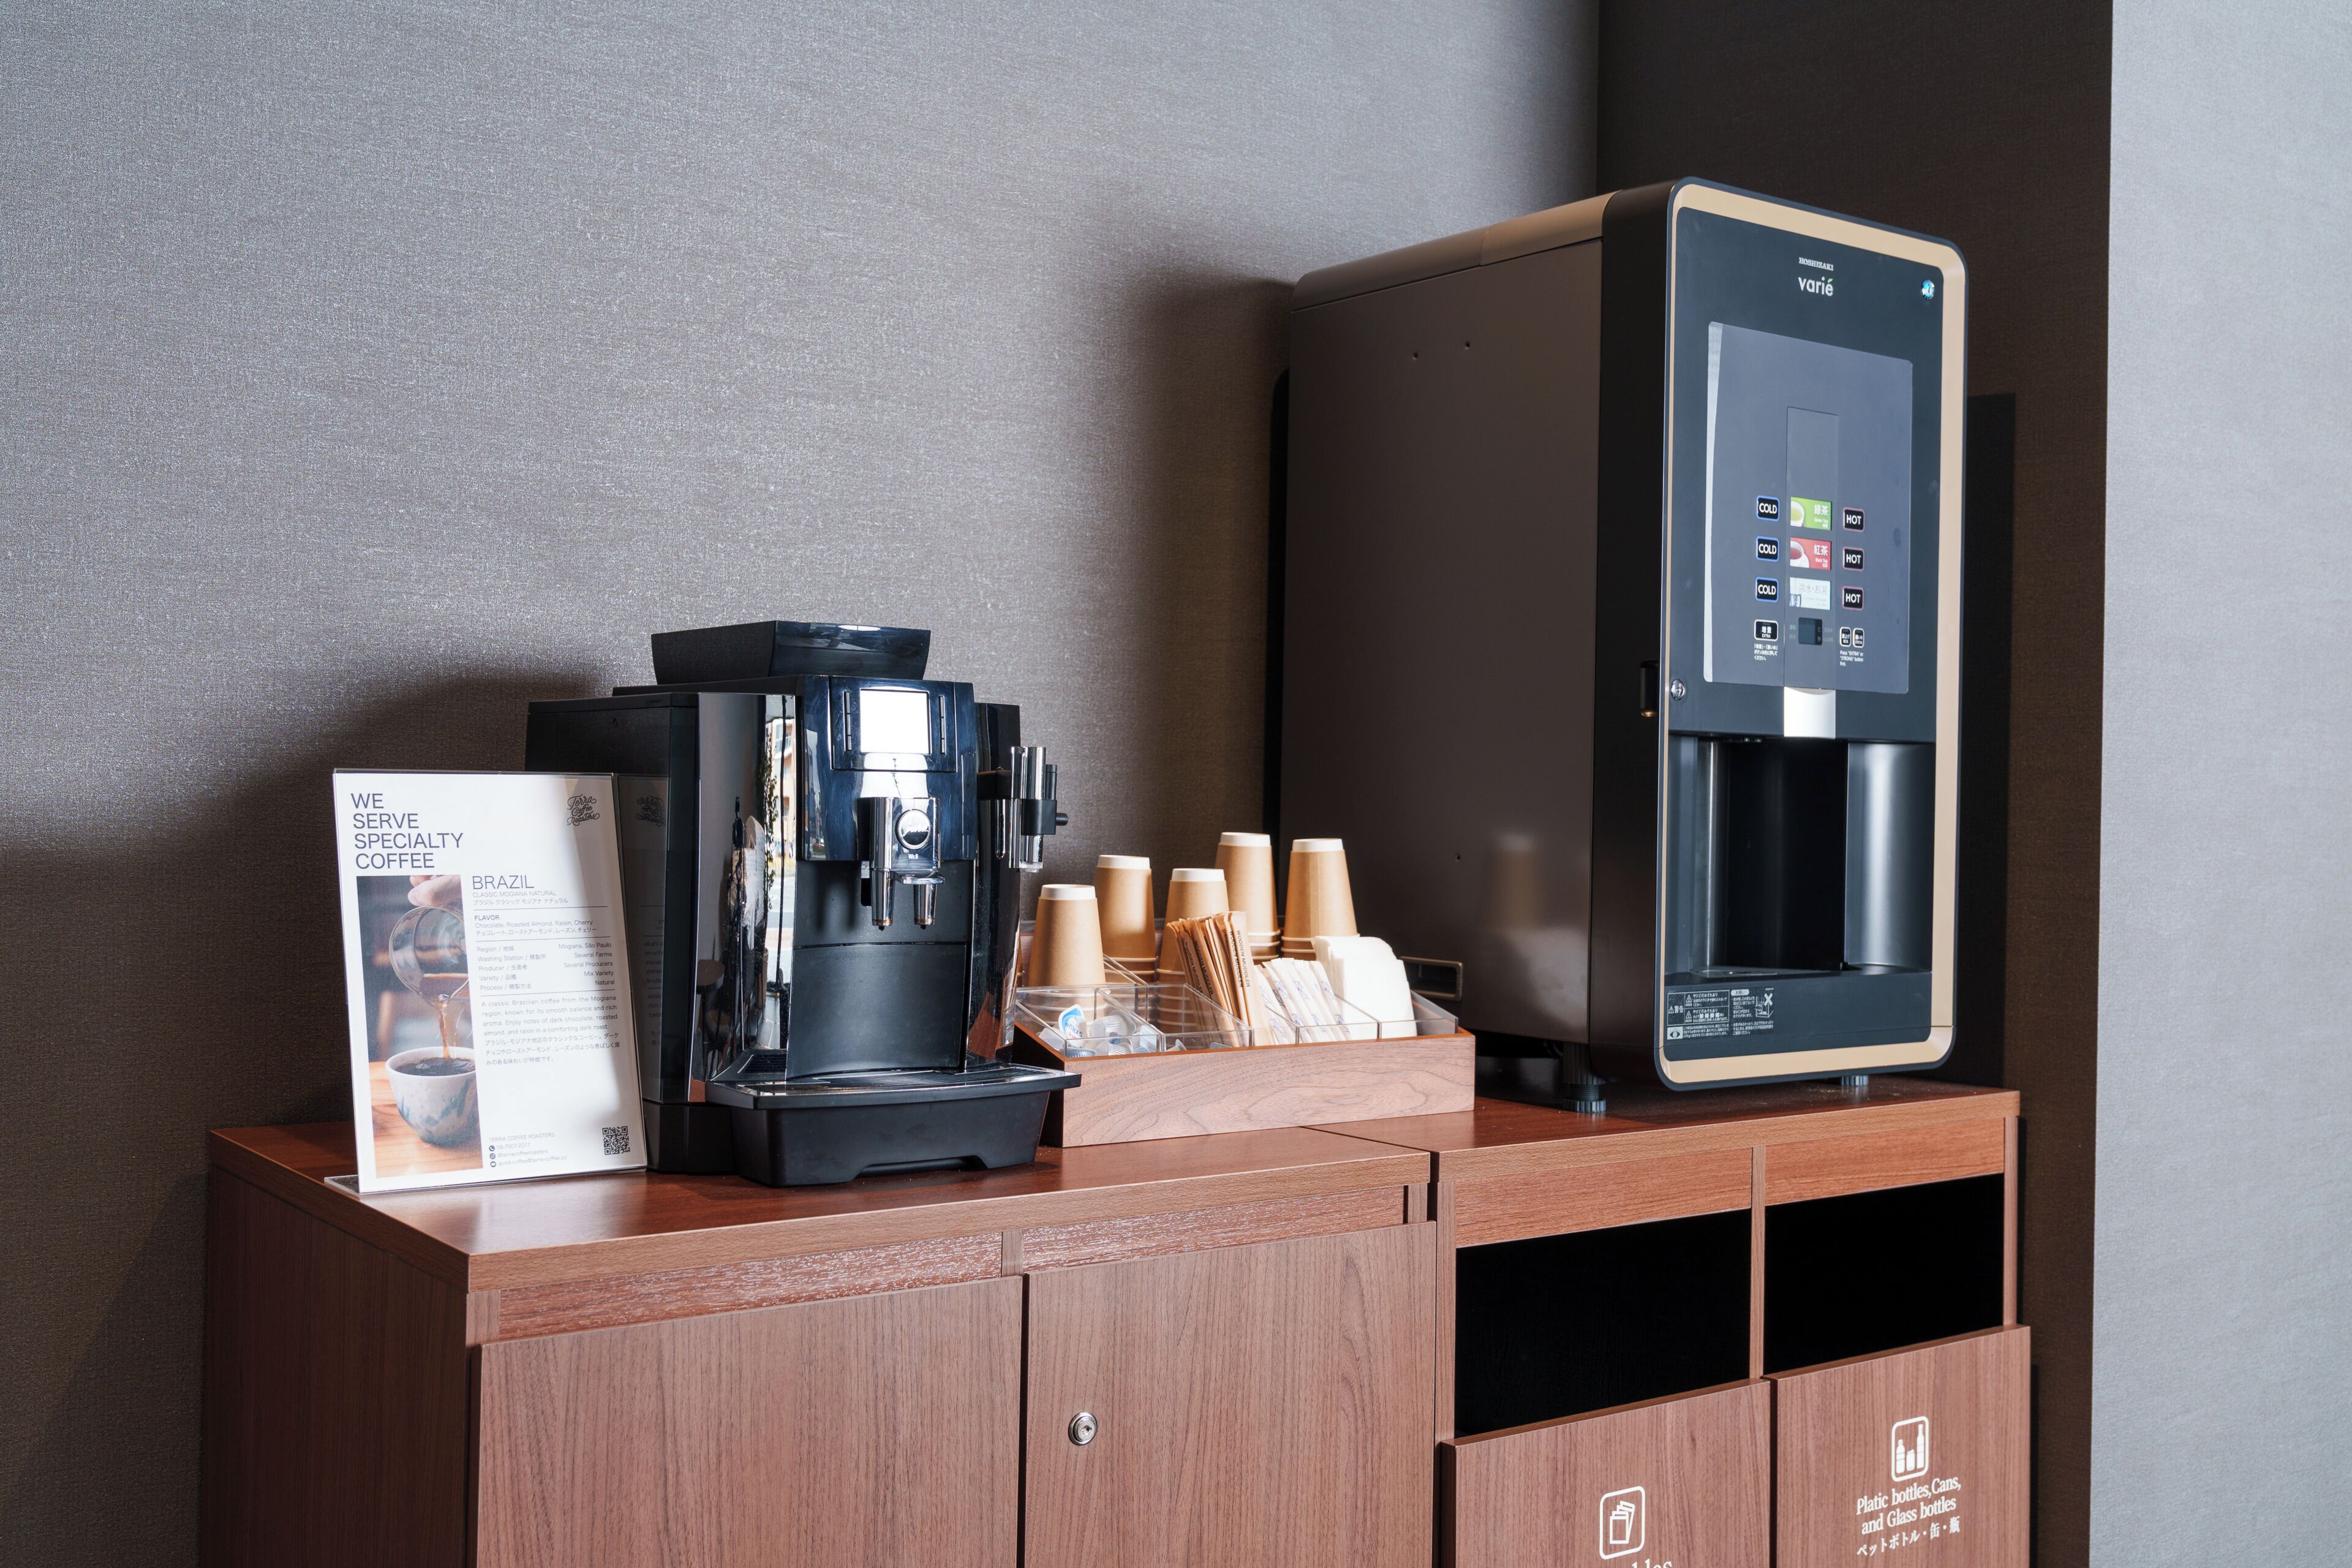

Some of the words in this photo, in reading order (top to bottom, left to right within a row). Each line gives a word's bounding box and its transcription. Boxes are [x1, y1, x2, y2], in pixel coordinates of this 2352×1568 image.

[1798, 257, 1834, 271] HOSHIZAKI
[1798, 276, 1833, 296] varié
[1758, 503, 1777, 514] COLD
[1846, 514, 1861, 525] HOT
[1758, 544, 1777, 554] COLD
[1814, 544, 1828, 556] 紅茶
[1845, 554, 1861, 564] HOT
[1758, 584, 1776, 595] COLD
[1845, 593, 1861, 604] HOT
[351, 793, 384, 809] WE
[567, 794, 597, 810] Terra
[567, 810, 600, 826] Roasters
[571, 804, 593, 816] Coffee
[353, 813, 419, 829] SERVE
[355, 833, 464, 849] SPECIALTY
[356, 853, 435, 869] COFFEE
[472, 875, 535, 889] BRAZIL
[1237, 929, 1245, 957] WOODEN
[1242, 957, 1251, 988] MUDDLER
[1234, 957, 1243, 988] MUDDLER
[1674, 1005, 1684, 1014] 警告
[1065, 1022, 1084, 1038] SYRUP
[1856, 1492, 1889, 1515] Platic
[1861, 1512, 1885, 1535] and
[1887, 1508, 1918, 1528] Glass
[1920, 1496, 1957, 1519] bottles
